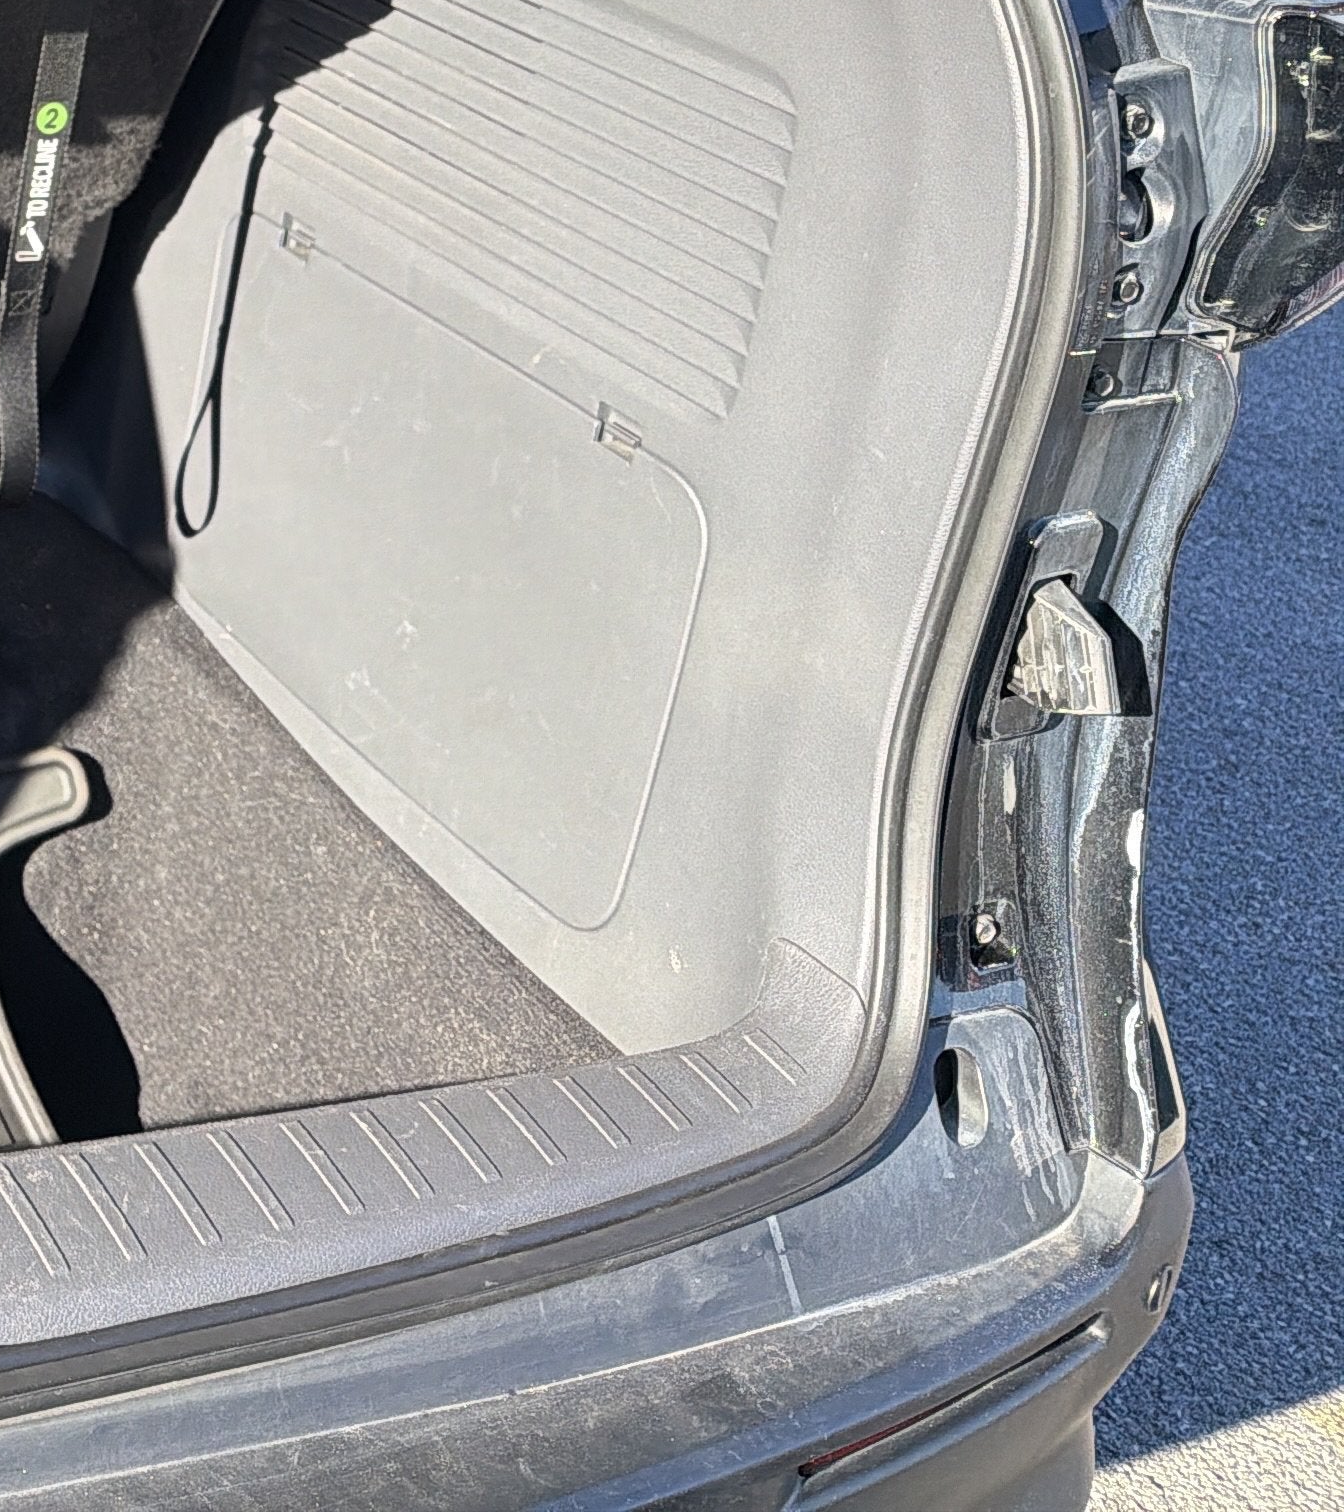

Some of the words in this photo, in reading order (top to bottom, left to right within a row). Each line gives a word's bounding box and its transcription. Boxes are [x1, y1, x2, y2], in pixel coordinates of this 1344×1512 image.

[44, 107, 60, 130] 2
[29, 138, 59, 198] RECLINE
[26, 199, 49, 219] TO
